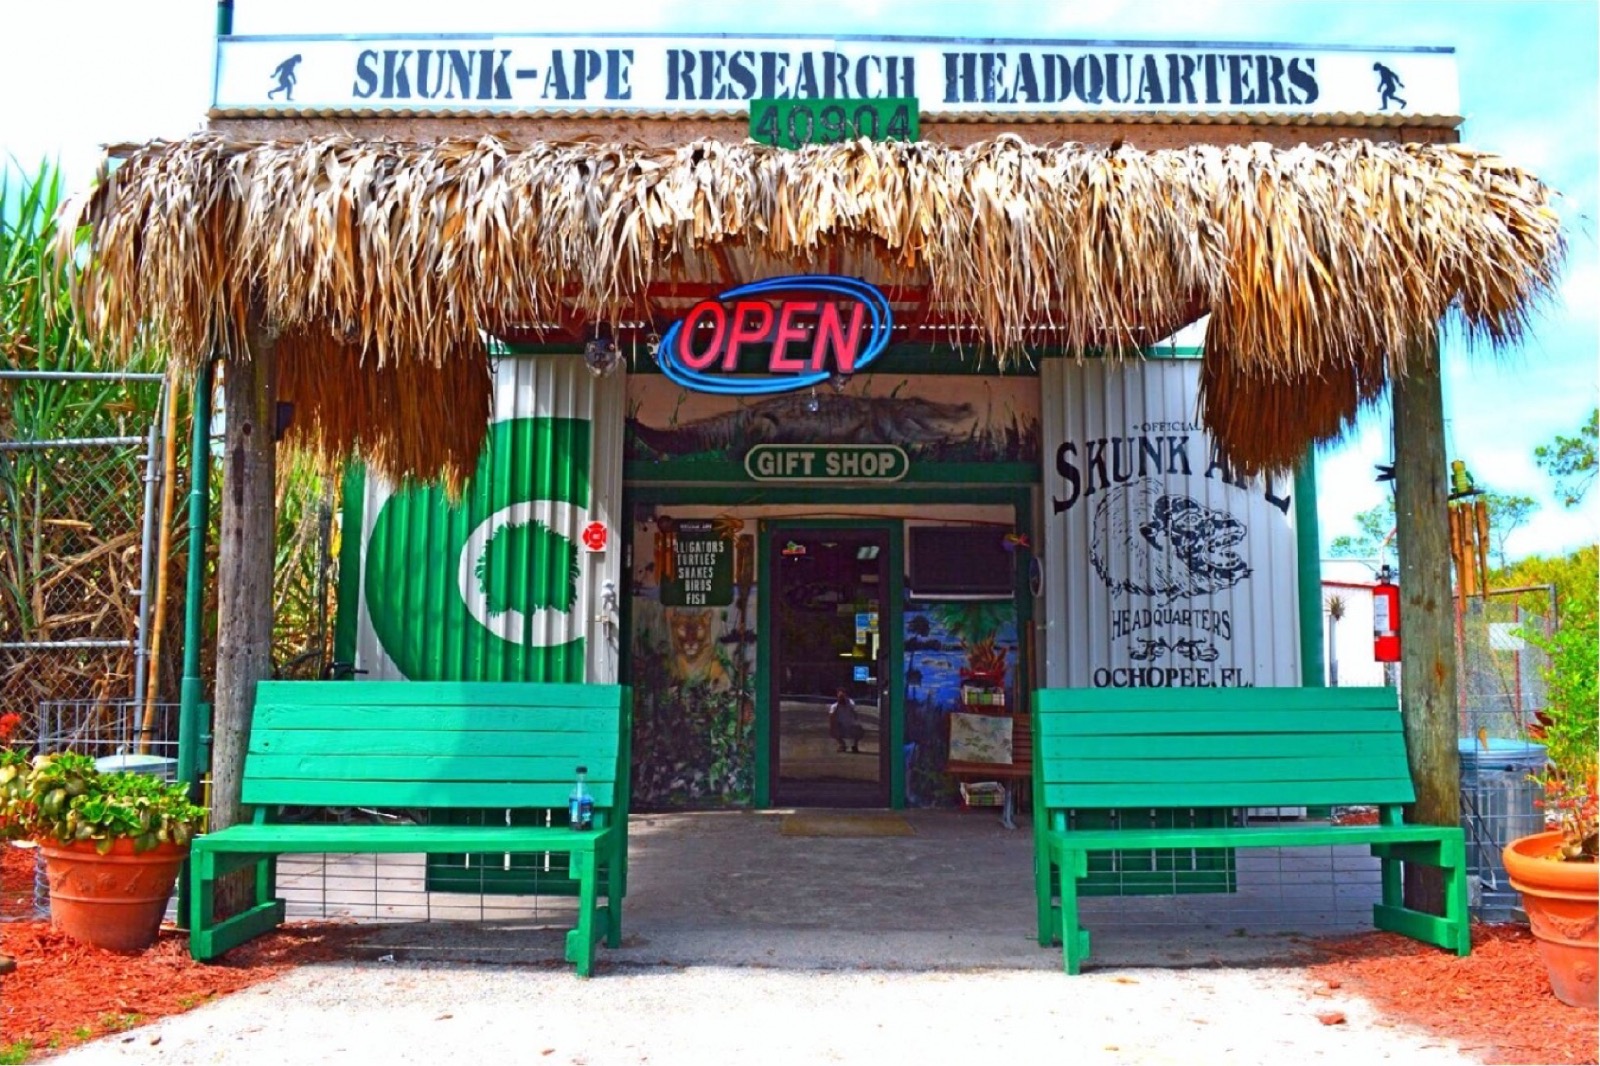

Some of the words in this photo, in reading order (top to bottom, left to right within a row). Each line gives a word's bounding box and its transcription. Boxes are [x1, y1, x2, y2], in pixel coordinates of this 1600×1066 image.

[353, 49, 634, 100] SKUNK-APE
[666, 50, 916, 101] RESEARCH
[942, 52, 1319, 104] HEADQUARTERS
[756, 104, 911, 149] 40904
[676, 300, 864, 372] OPEN
[757, 451, 816, 475] GIFT
[825, 452, 896, 477] SHOP
[1053, 436, 1193, 516] SKUNK
[677, 554, 716, 566] TURTLES
[678, 567, 713, 579] SNAKES
[684, 579, 712, 592] BIRDS
[685, 593, 706, 605] FISH
[1111, 609, 1232, 641] HEADQUARTERS
